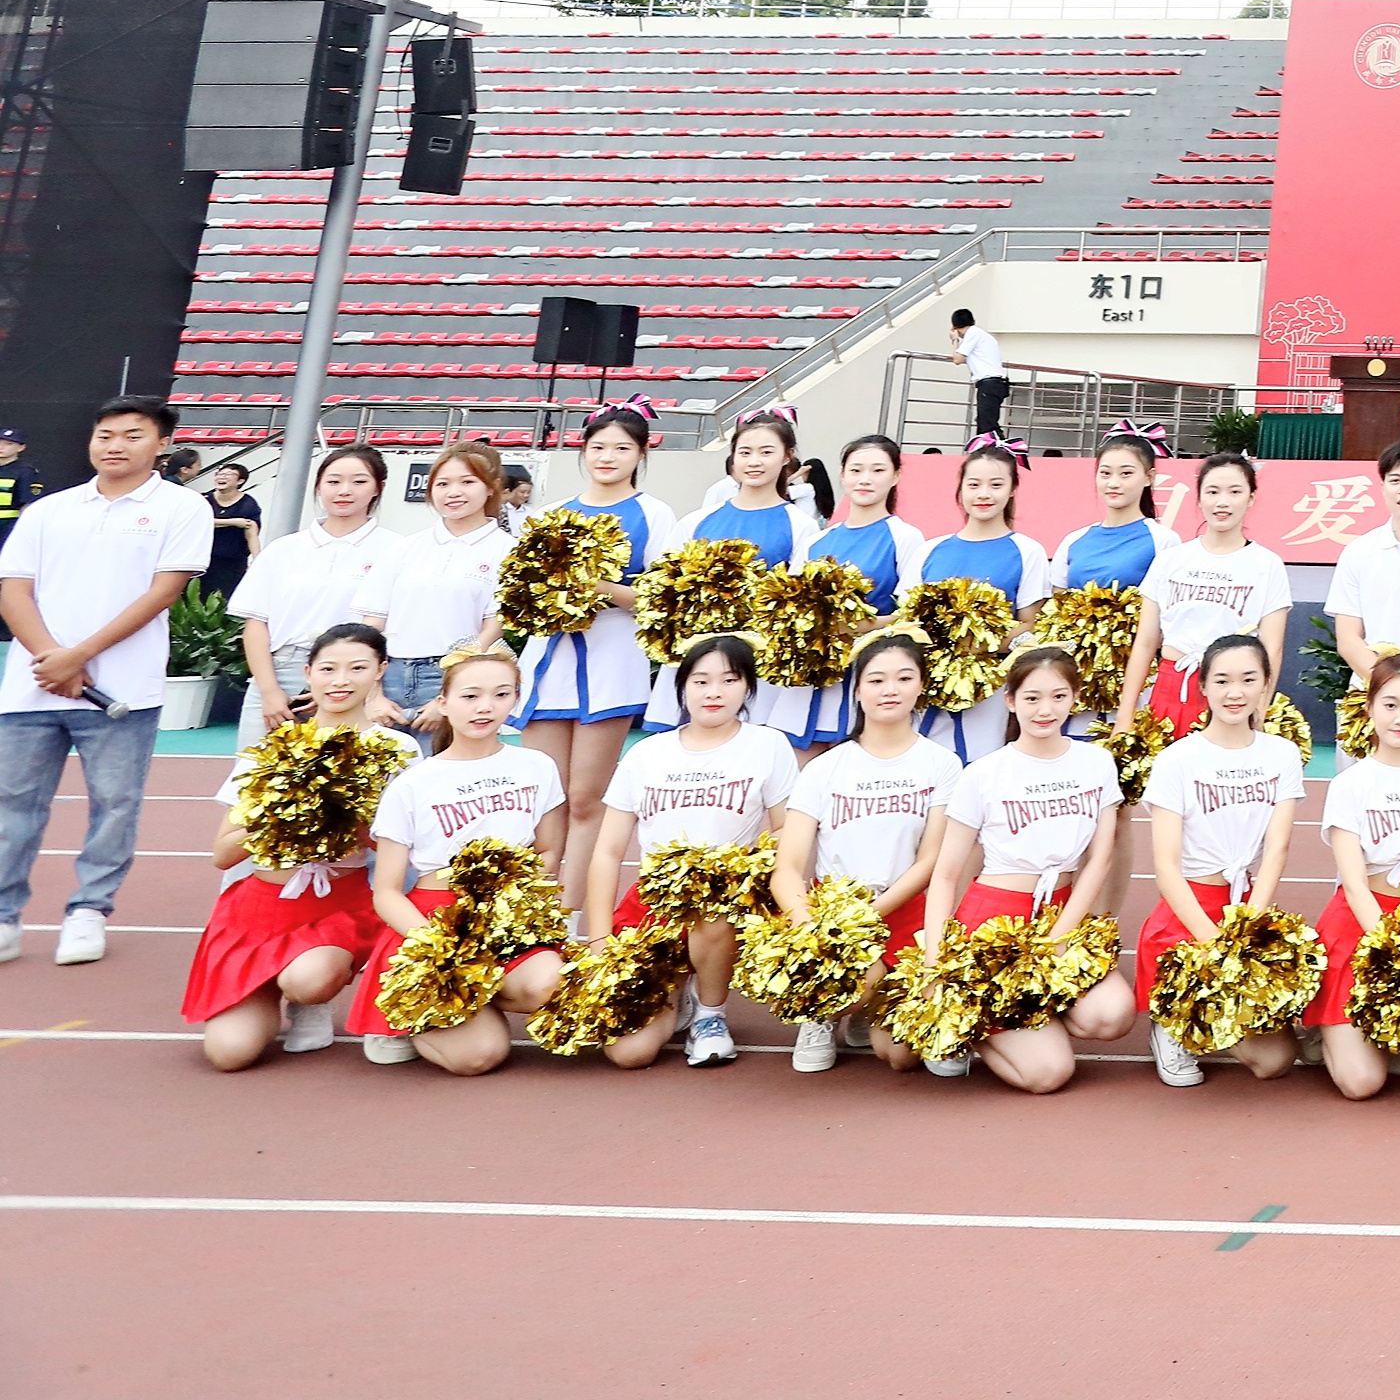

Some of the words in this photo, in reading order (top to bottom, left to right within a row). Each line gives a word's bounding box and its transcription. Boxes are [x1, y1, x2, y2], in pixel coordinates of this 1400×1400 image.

[1088, 273, 1163, 300] 东1口
[1102, 308, 1134, 322] East
[1138, 308, 1145, 322] 1
[1186, 570, 1234, 582] NATIONAL
[664, 770, 726, 783] NATIONAL
[855, 778, 917, 791] NATIONAL
[1024, 780, 1081, 795] NATIONAL
[639, 777, 754, 821] UNIVERSITY
[1001, 786, 1104, 835] UNIVERSITY
